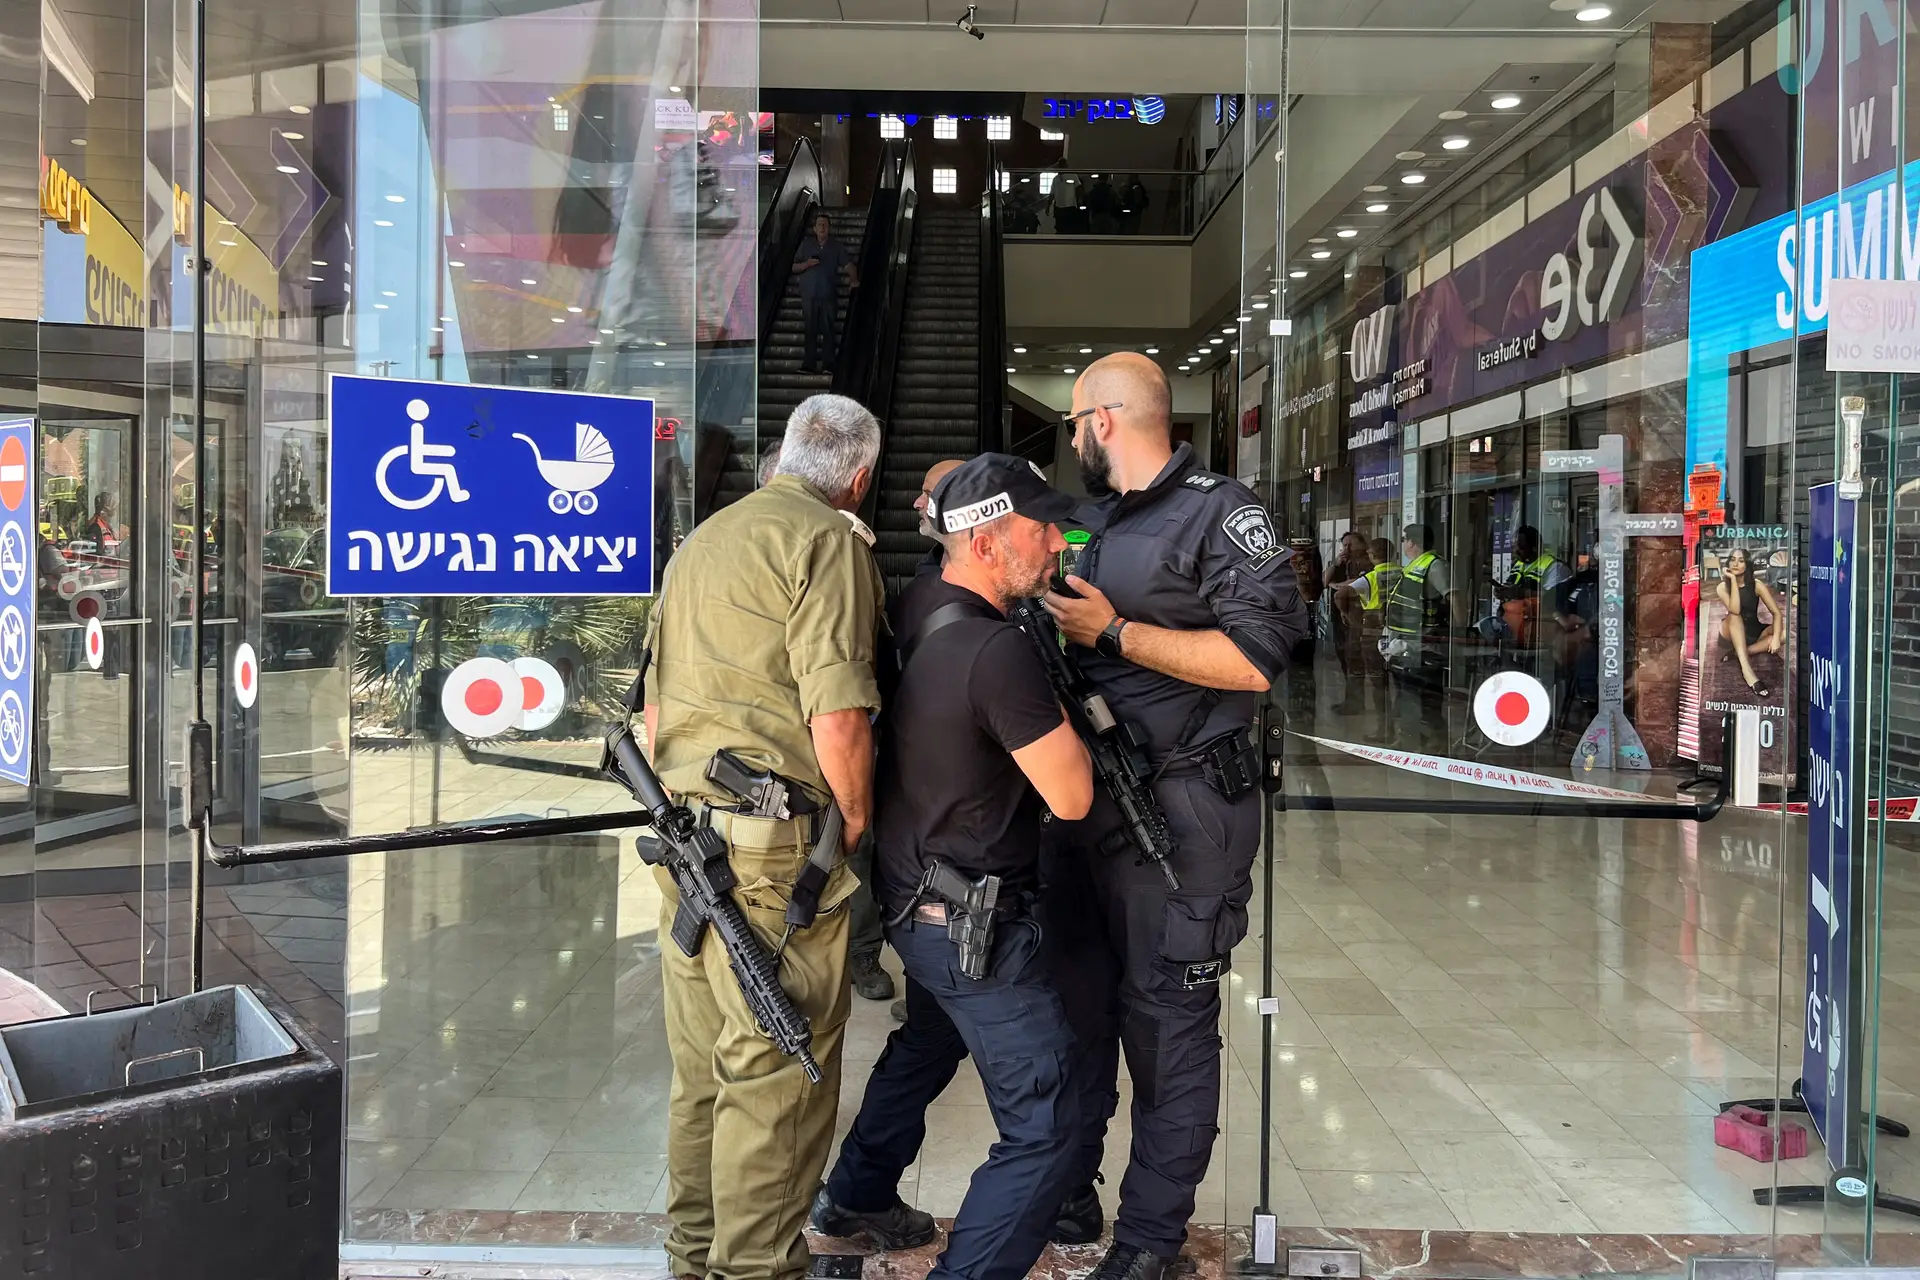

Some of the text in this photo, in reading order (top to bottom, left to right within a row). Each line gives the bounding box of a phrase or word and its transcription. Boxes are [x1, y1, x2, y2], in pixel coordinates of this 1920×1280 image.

[1043, 97, 1132, 123] בנק יהב
[1836, 343, 1861, 359] NO
[1548, 454, 1594, 468] בקבוקים
[947, 498, 1009, 528] משטרה
[1625, 516, 1677, 530] כלי כתיבה
[348, 530, 637, 572] יציאה נגישה
[1603, 559, 1620, 599] BACK
[1603, 617, 1619, 678] SCHOOL
[1705, 701, 1728, 711] לנשים
[1447, 764, 1473, 776] משטרת
[1485, 770, 1508, 784] ישראל
